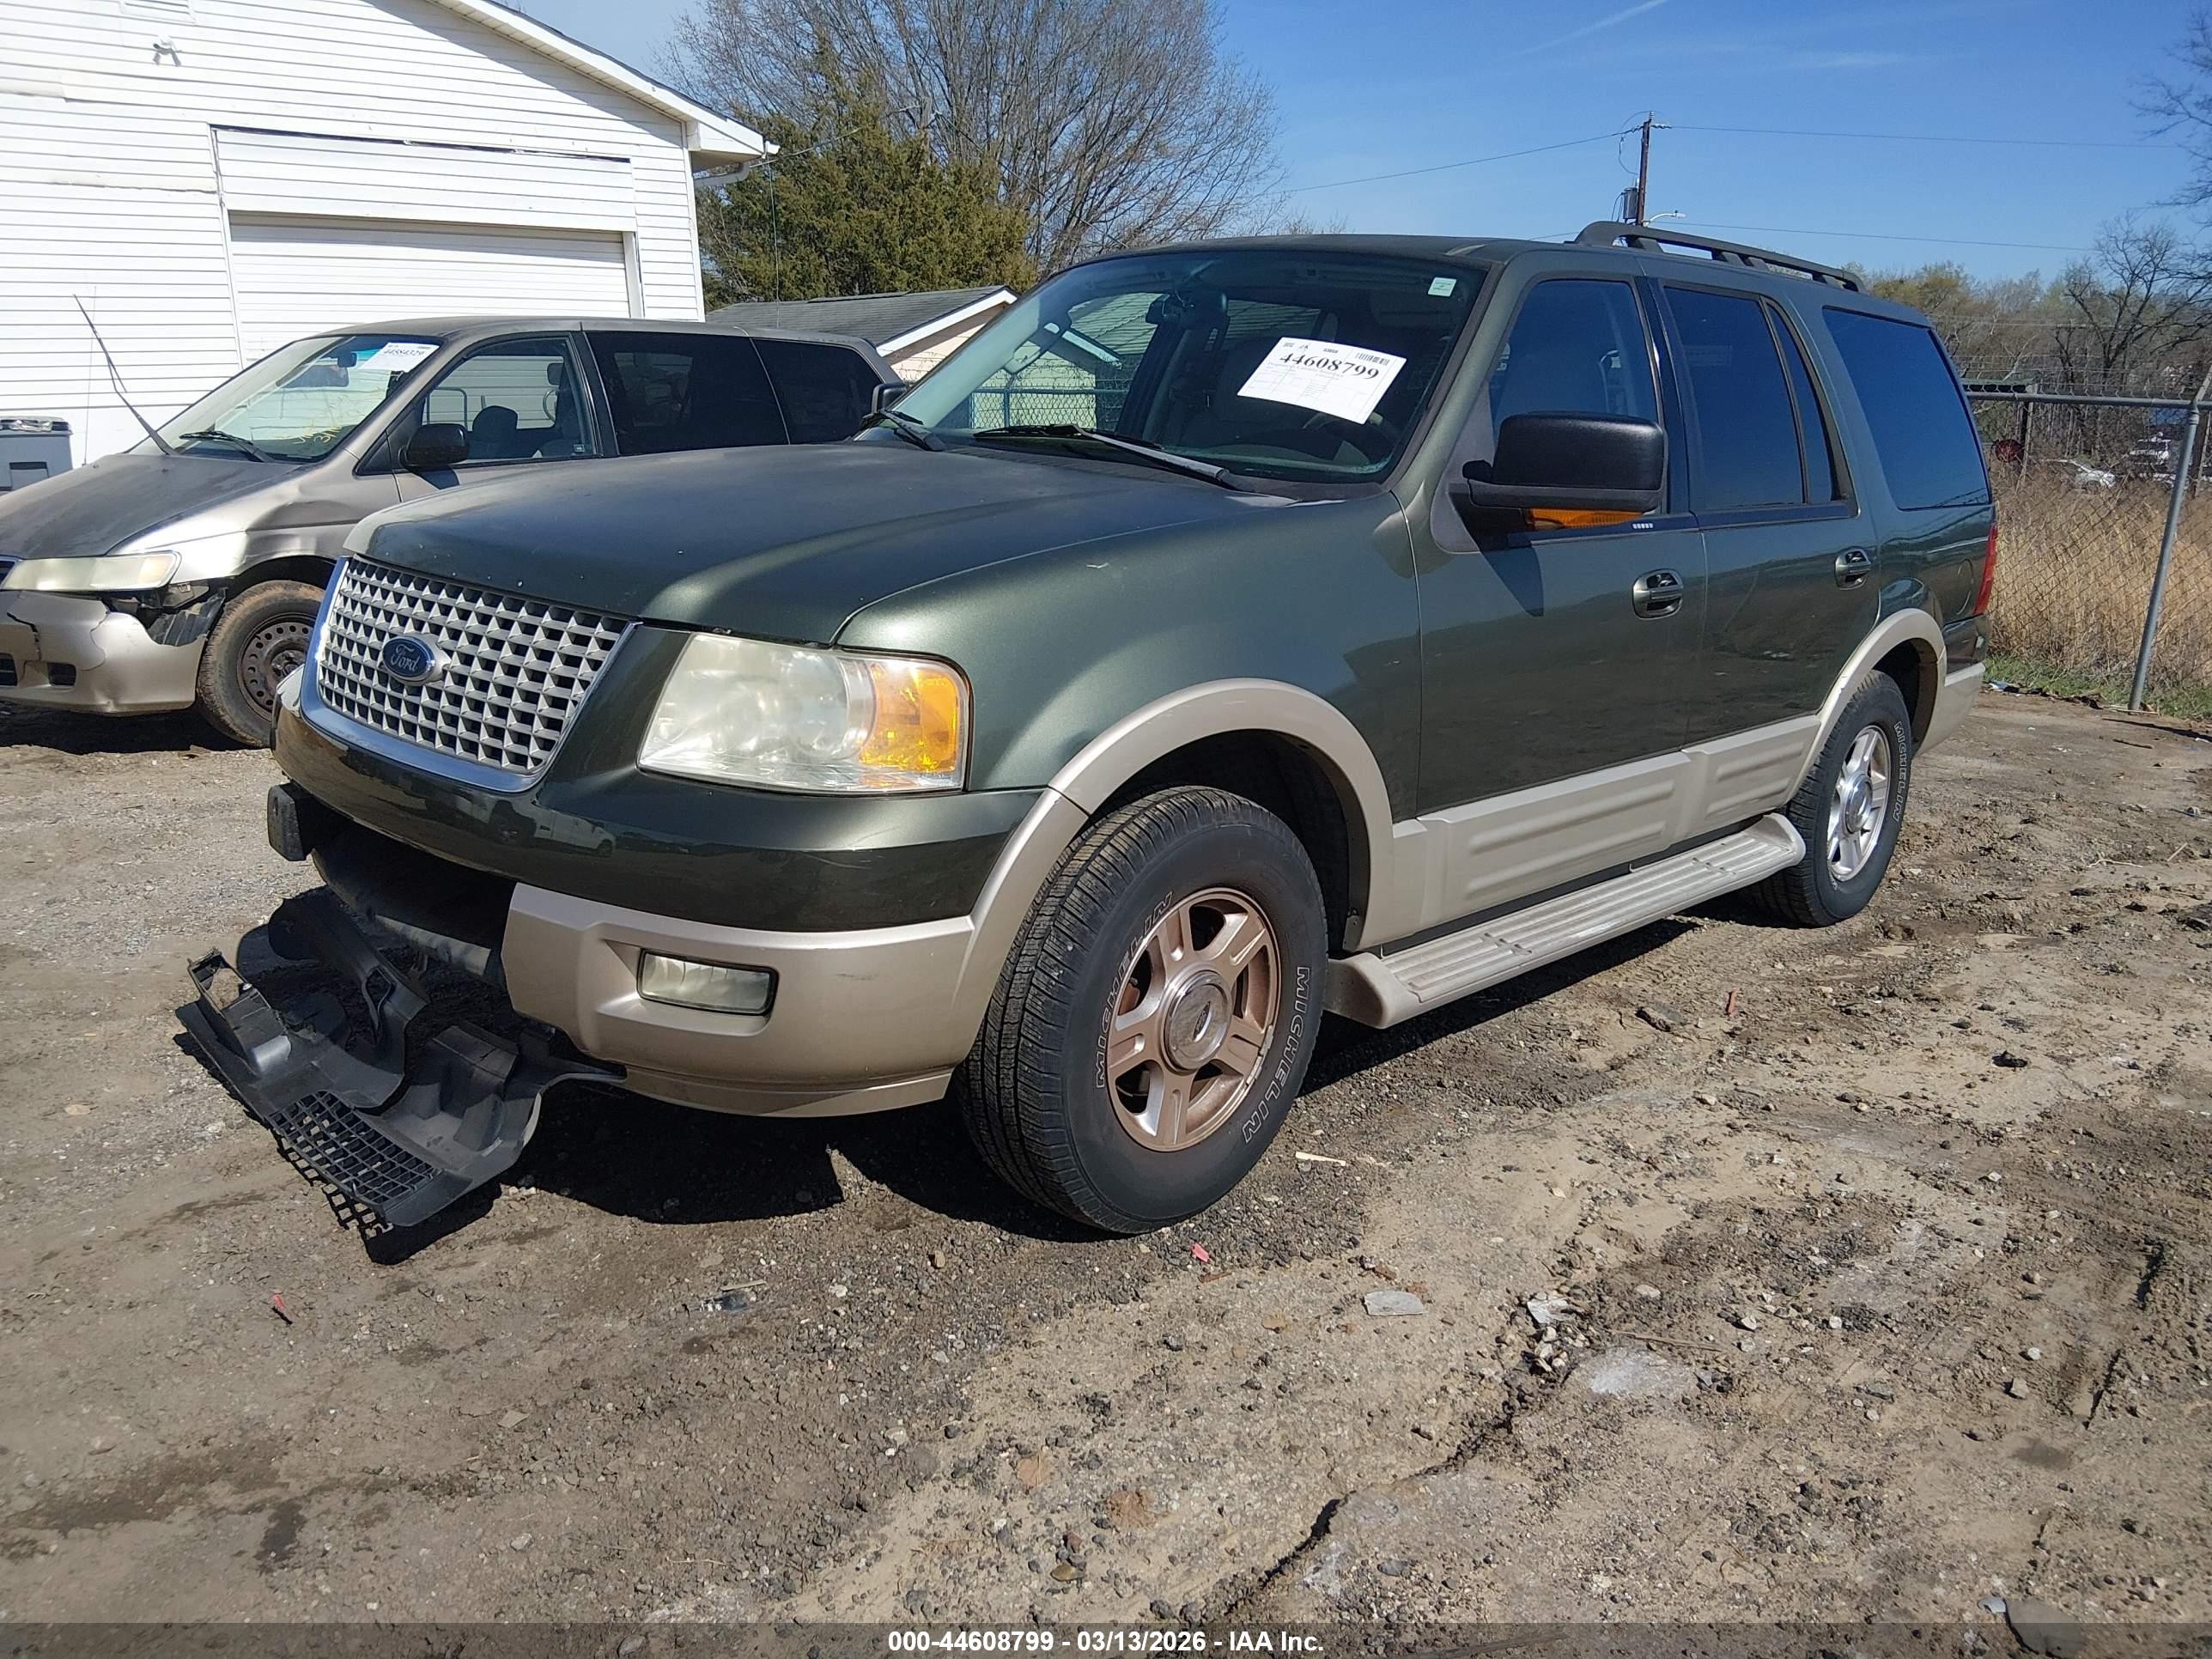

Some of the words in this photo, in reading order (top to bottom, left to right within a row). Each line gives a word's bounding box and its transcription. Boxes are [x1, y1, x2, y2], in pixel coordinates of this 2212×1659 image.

[1279, 352, 1379, 380] 44608799
[391, 643, 421, 672] Ford
[1893, 720, 1907, 822] MICHELIN
[1096, 891, 1172, 1088] MICHELIN
[1242, 966, 1310, 1145] MICHELIN
